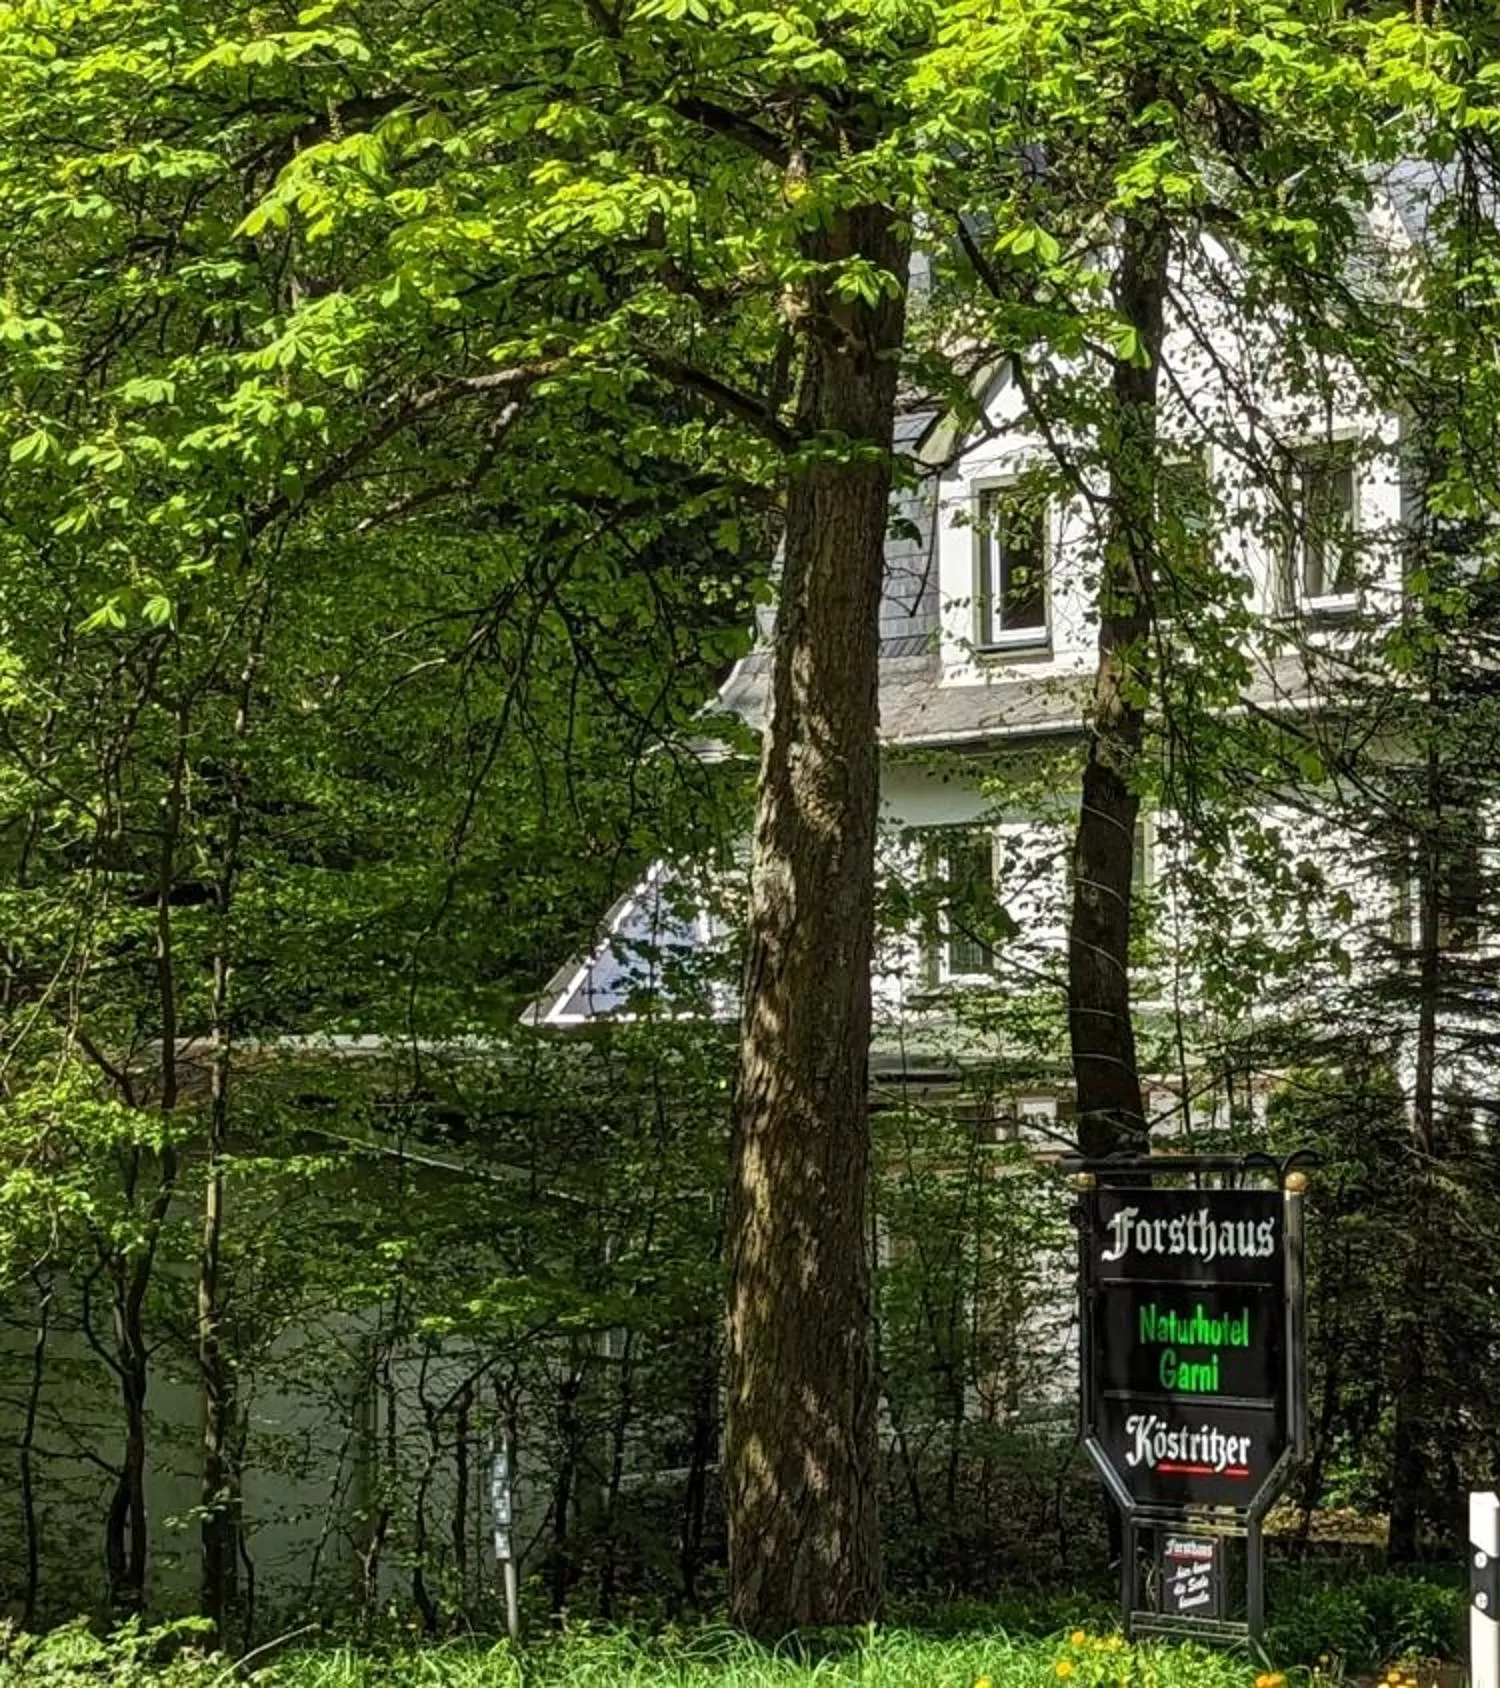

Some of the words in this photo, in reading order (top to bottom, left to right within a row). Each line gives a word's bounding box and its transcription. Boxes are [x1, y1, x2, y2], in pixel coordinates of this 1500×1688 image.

[1101, 1206, 1276, 1263] Forsthaus
[1139, 1303, 1250, 1347] Naturhotel
[1159, 1349, 1220, 1391] Garni
[1125, 1414, 1251, 1473] Köstritzer
